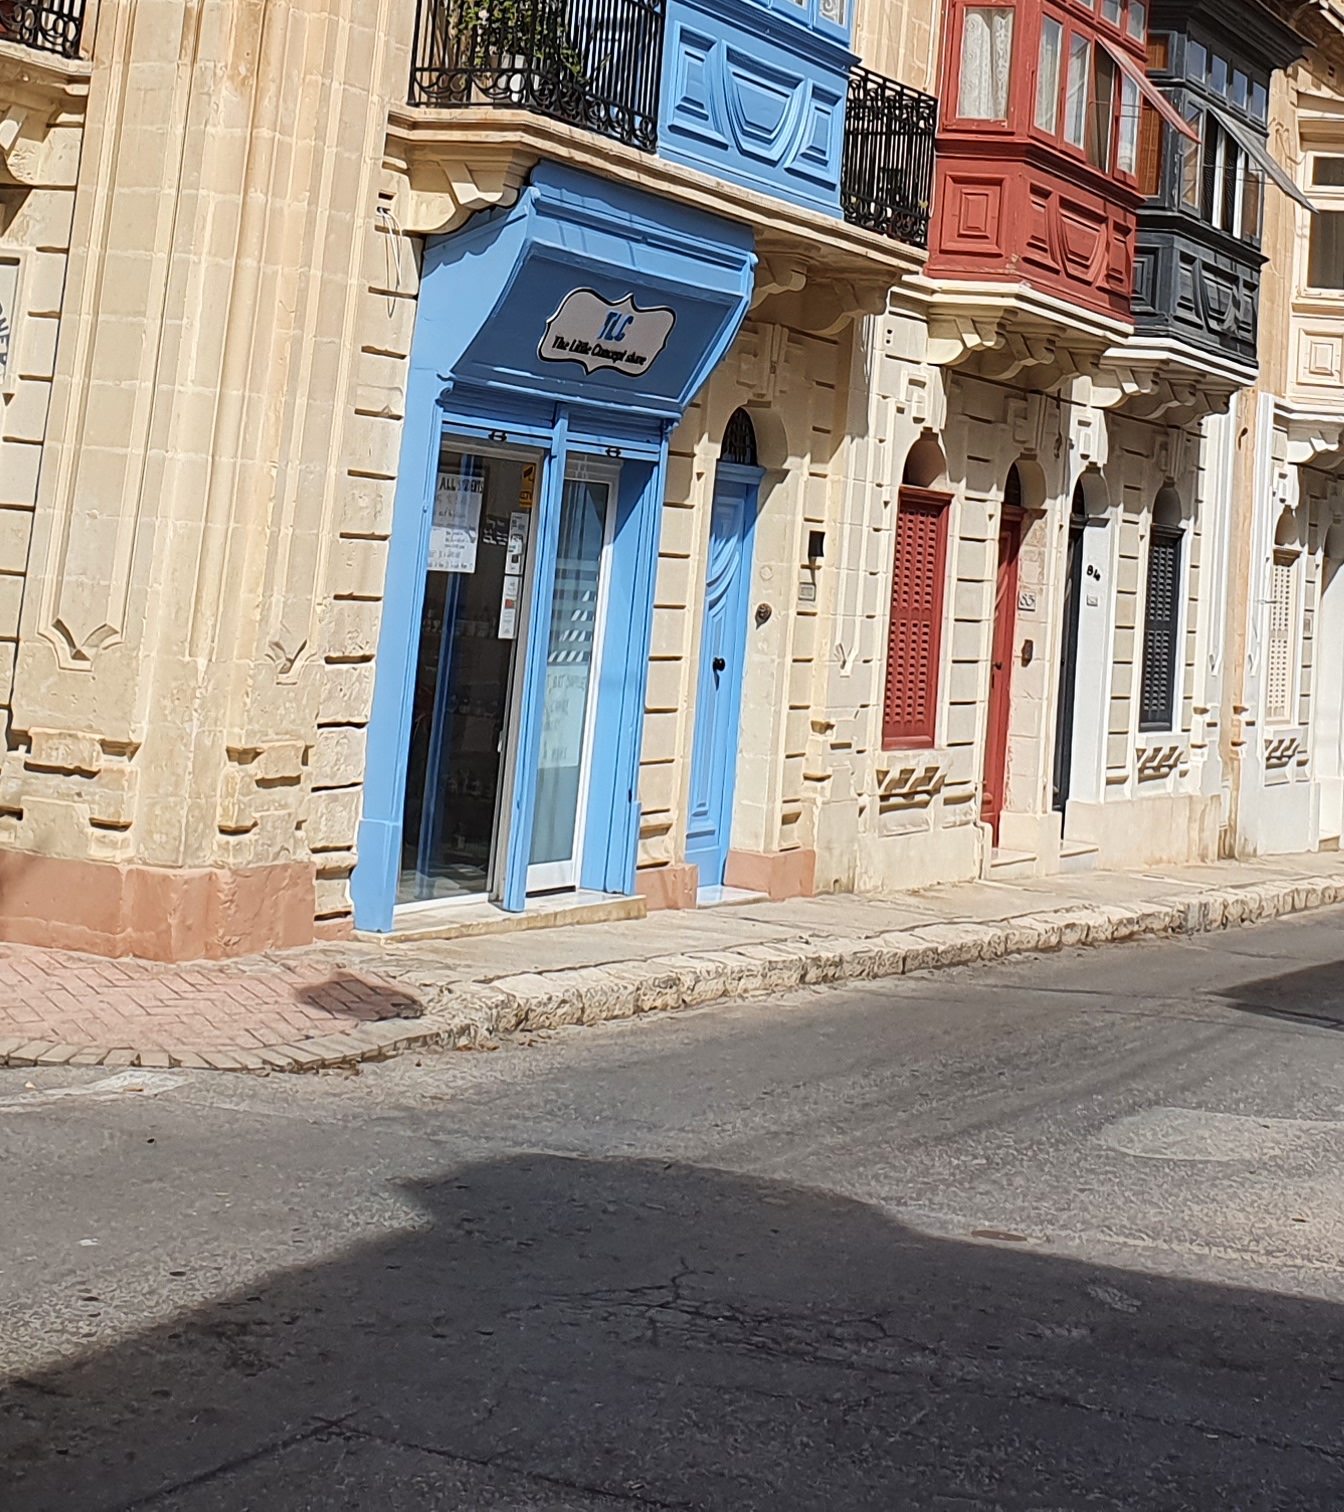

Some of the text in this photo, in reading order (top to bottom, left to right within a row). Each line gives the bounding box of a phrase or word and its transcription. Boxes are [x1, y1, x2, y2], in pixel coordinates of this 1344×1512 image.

[597, 311, 634, 341] TLC
[552, 335, 570, 350] The
[569, 339, 592, 355] Little
[591, 343, 627, 364] Concept
